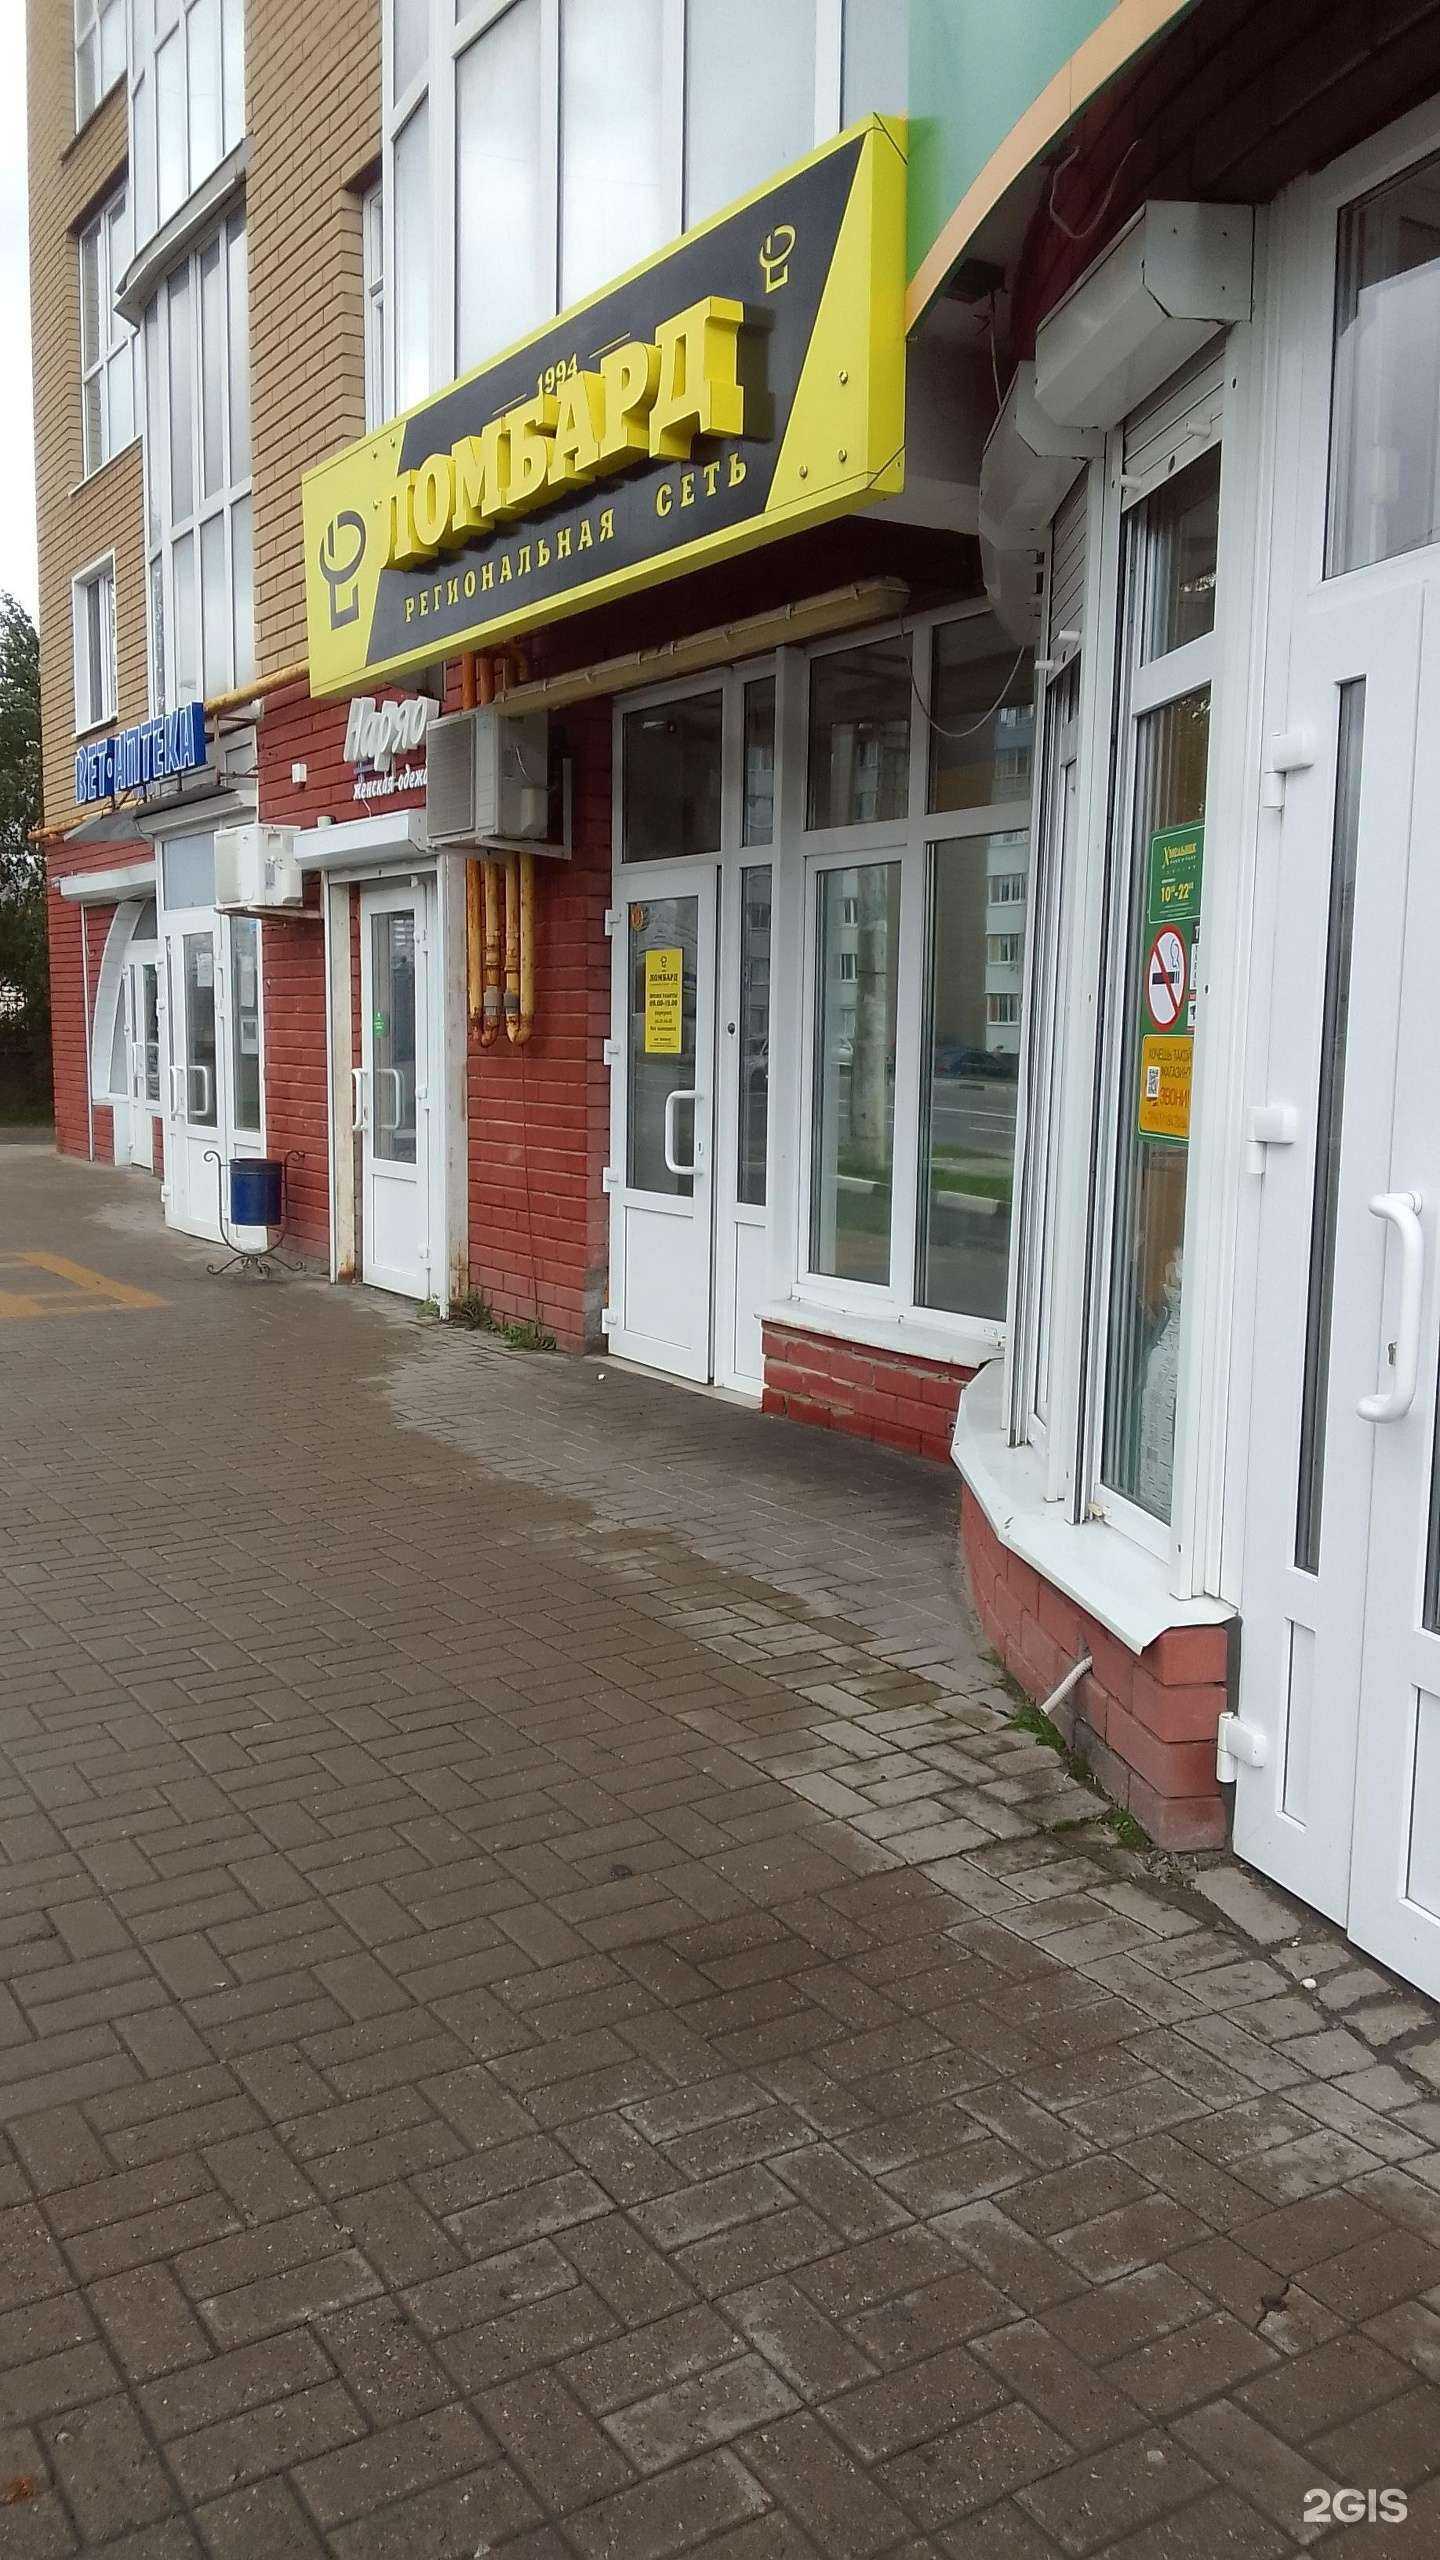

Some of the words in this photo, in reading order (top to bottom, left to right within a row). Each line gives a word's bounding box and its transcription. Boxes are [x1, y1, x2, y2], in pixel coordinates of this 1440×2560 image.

[382, 296, 744, 570] ЛОМБАРД
[537, 352, 579, 401] 1994
[404, 507, 615, 624] РЕГИОНАЛЬНАЯ
[655, 452, 748, 518] СЕТЬ
